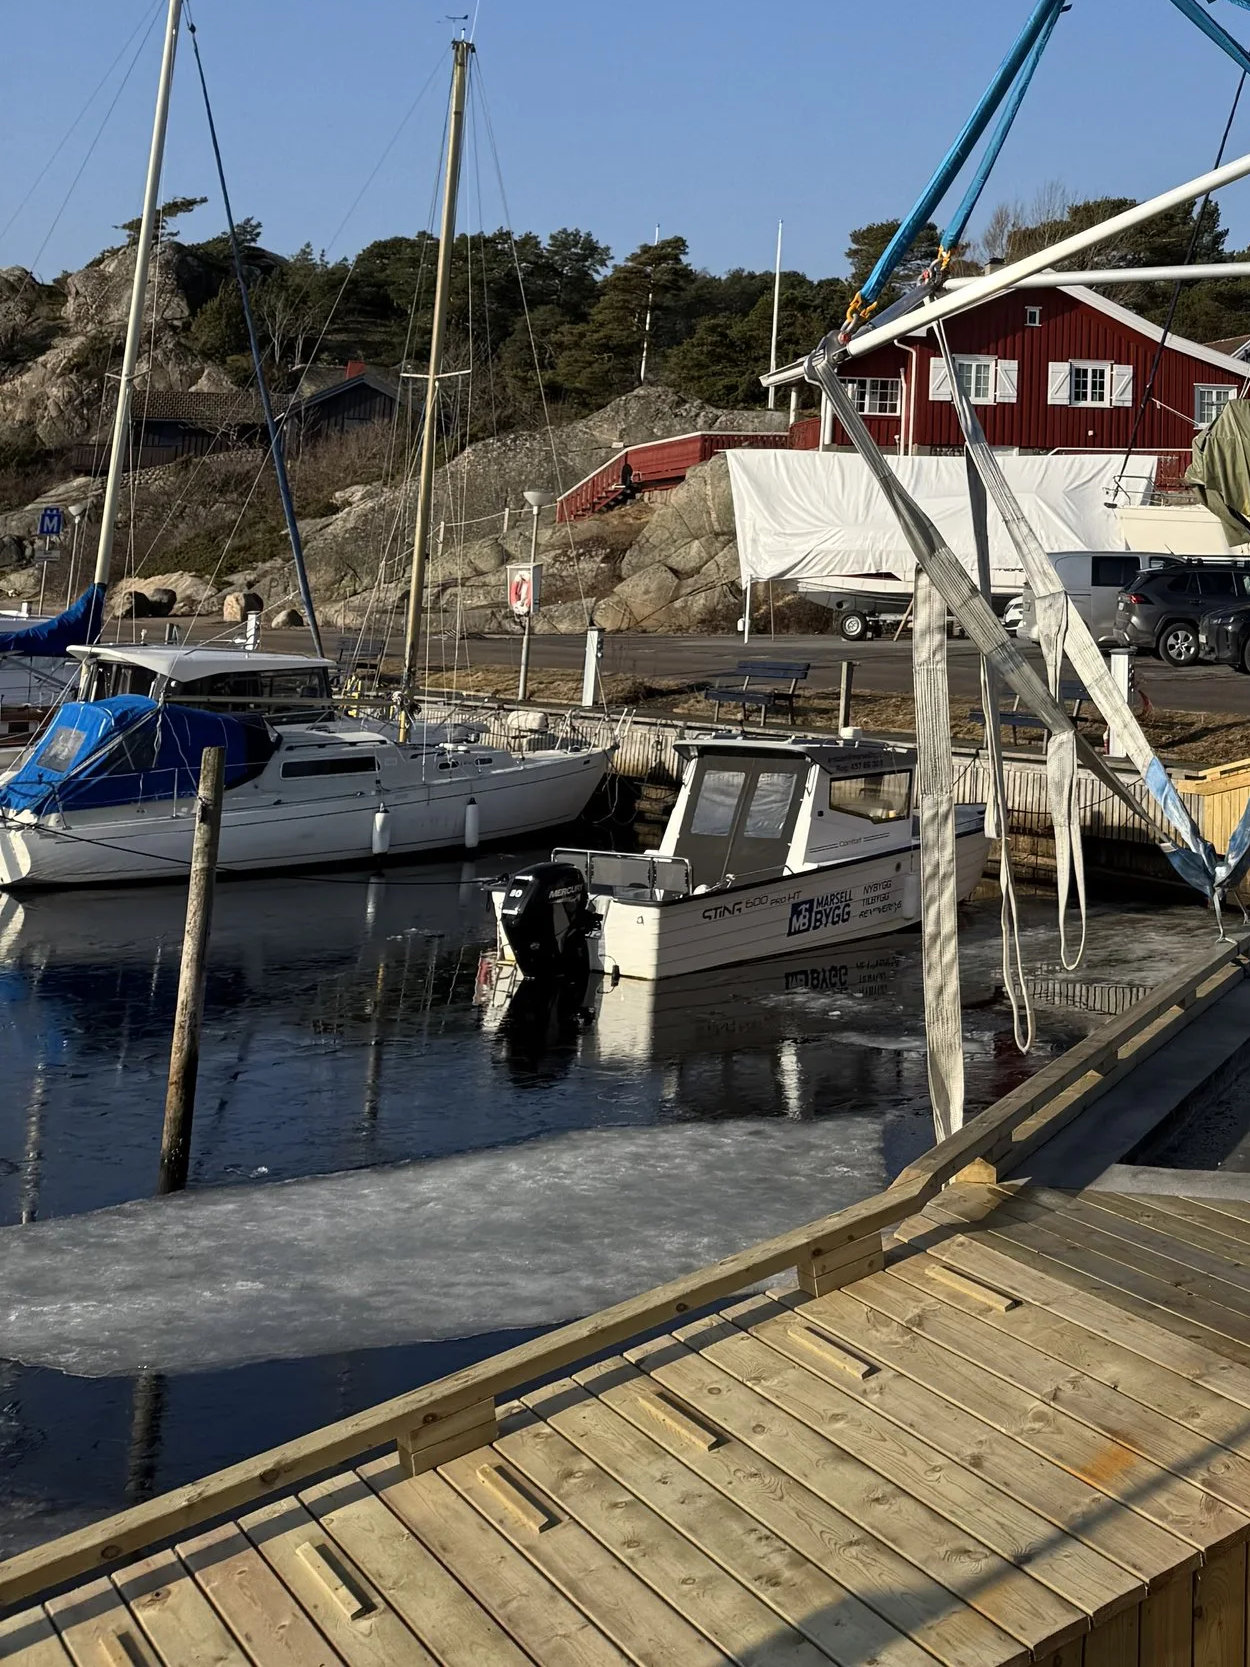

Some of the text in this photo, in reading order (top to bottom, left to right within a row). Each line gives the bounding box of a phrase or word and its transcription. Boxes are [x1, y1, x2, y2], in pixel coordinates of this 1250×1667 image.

[43, 516, 58, 532] M
[548, 883, 584, 899] MERCURY
[863, 880, 892, 895] NYBYGG
[815, 890, 853, 910] MARSELL
[862, 892, 890, 907] TILBYGG
[702, 901, 743, 921] STING
[745, 895, 769, 909] 600
[770, 896, 787, 906] PRO
[812, 903, 851, 931] BYGG
